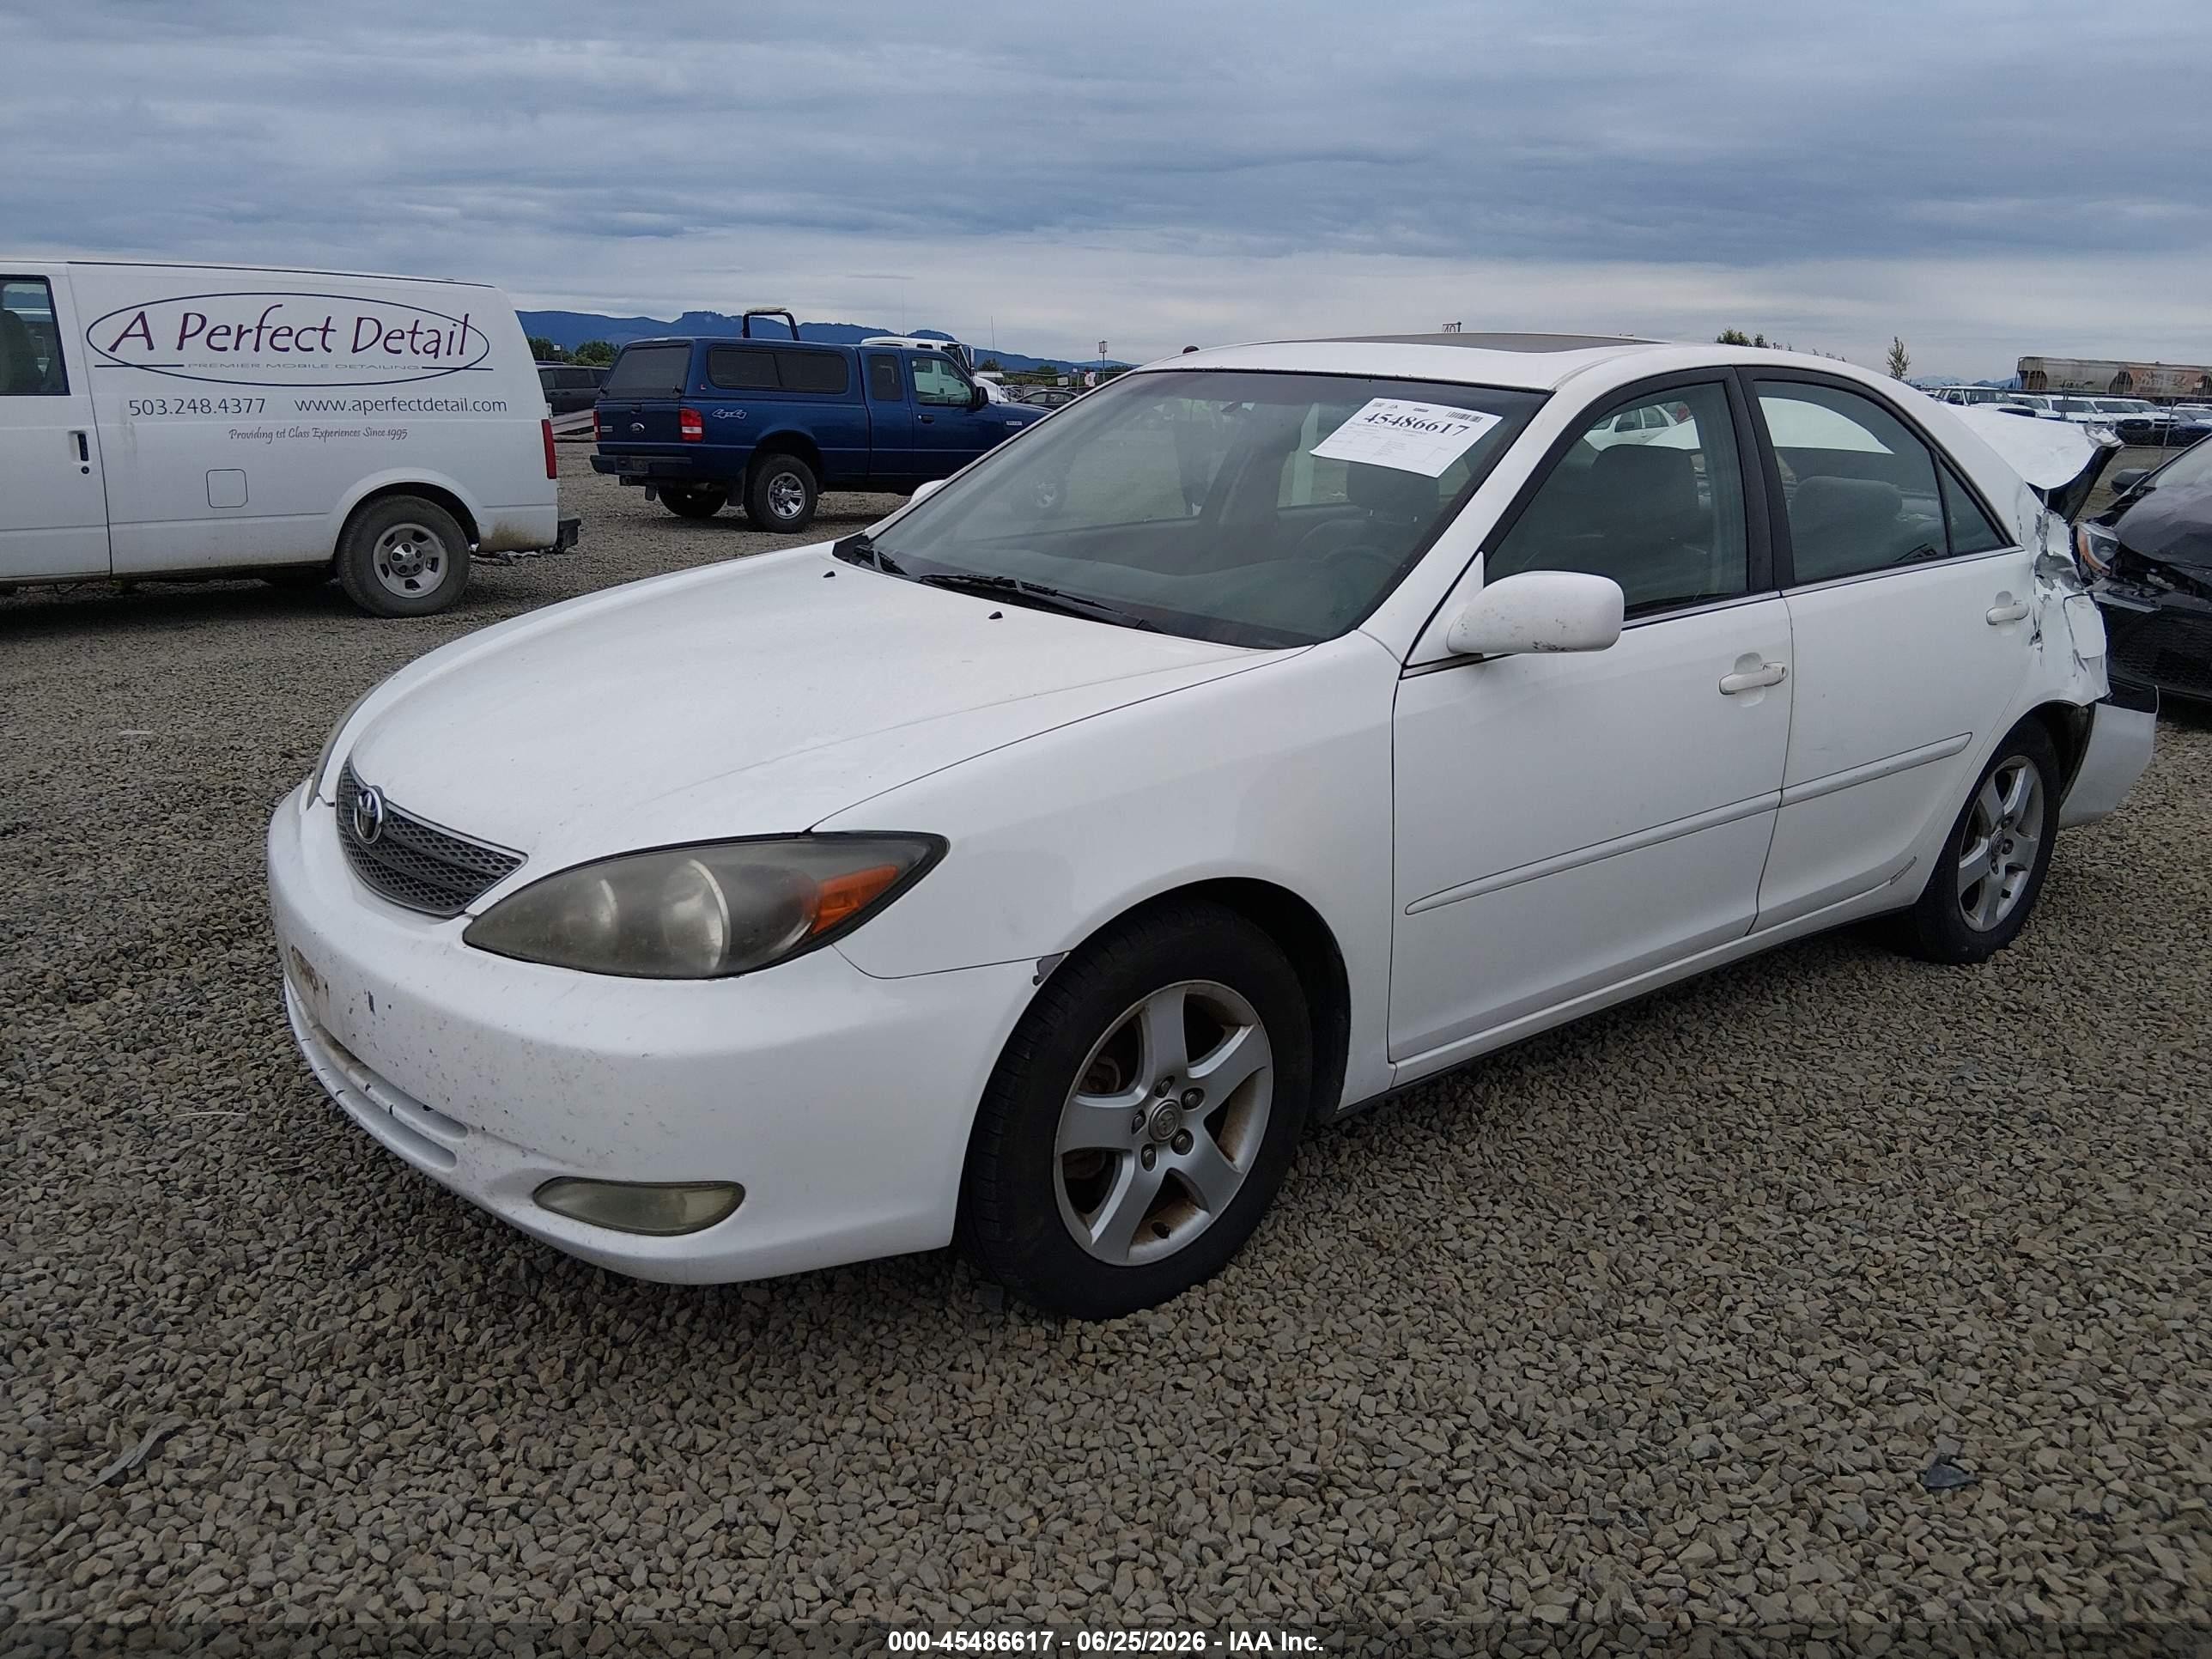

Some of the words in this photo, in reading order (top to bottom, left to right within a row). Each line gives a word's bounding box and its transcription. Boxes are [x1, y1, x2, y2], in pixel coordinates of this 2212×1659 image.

[108, 311, 155, 352] A
[176, 304, 337, 353] Perfect
[351, 313, 470, 359] Detail
[129, 398, 265, 416] 503.248.4377
[295, 396, 507, 416] www.aperfectdetail.com
[1364, 412, 1470, 436] 45486617
[228, 426, 273, 445] Providing
[276, 428, 287, 439] 1st
[289, 426, 310, 438] Class
[312, 427, 361, 443] Experiences
[362, 427, 386, 437] Since
[387, 428, 408, 441] 1995
